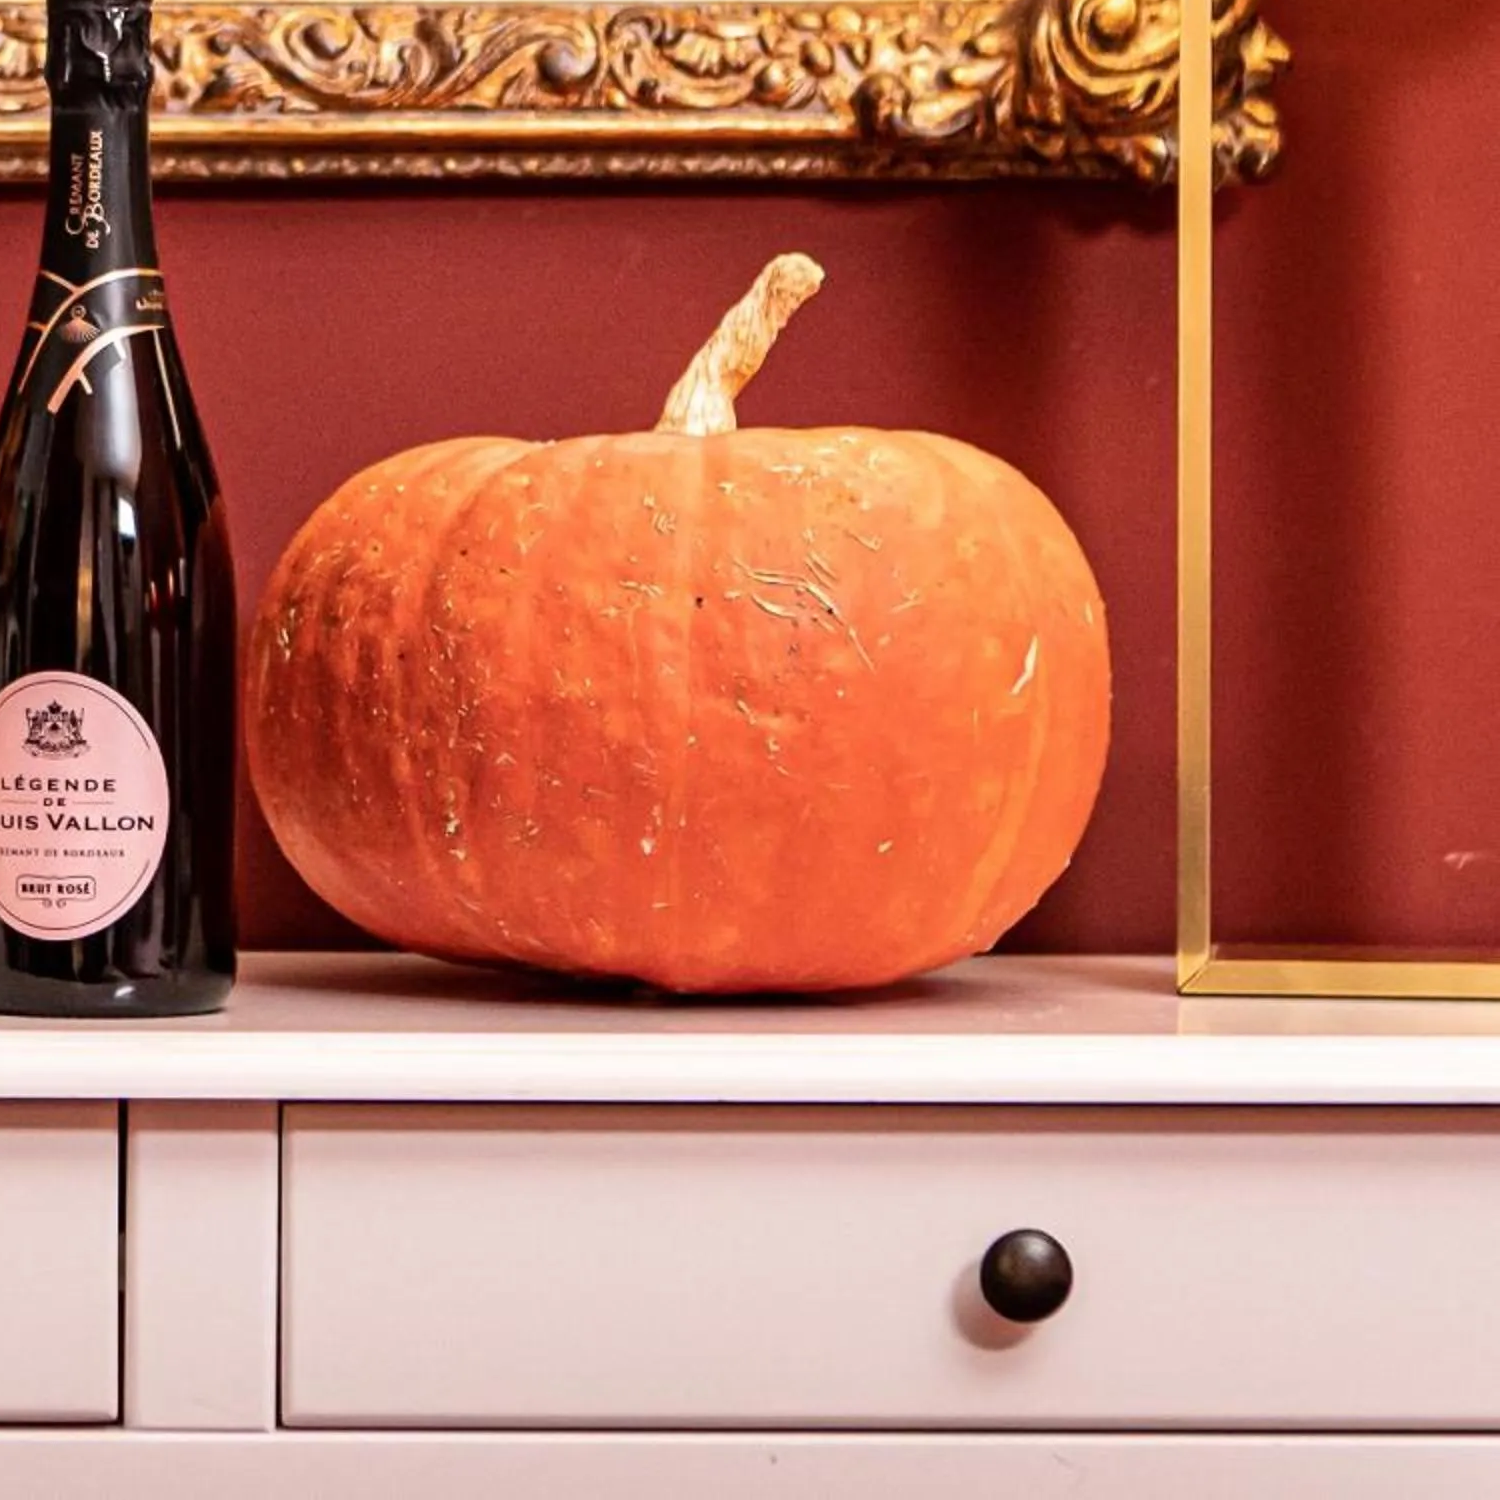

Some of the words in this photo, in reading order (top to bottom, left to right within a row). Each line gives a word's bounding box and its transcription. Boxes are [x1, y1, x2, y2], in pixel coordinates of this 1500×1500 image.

[84, 129, 111, 236] BORDEAUX
[86, 230, 100, 249] DE
[1, 775, 116, 792] LÉGENDE
[43, 797, 67, 807] DE
[46, 813, 154, 831] VALLON
[21, 883, 51, 893] BRUT
[57, 882, 90, 894] ROSÉ
